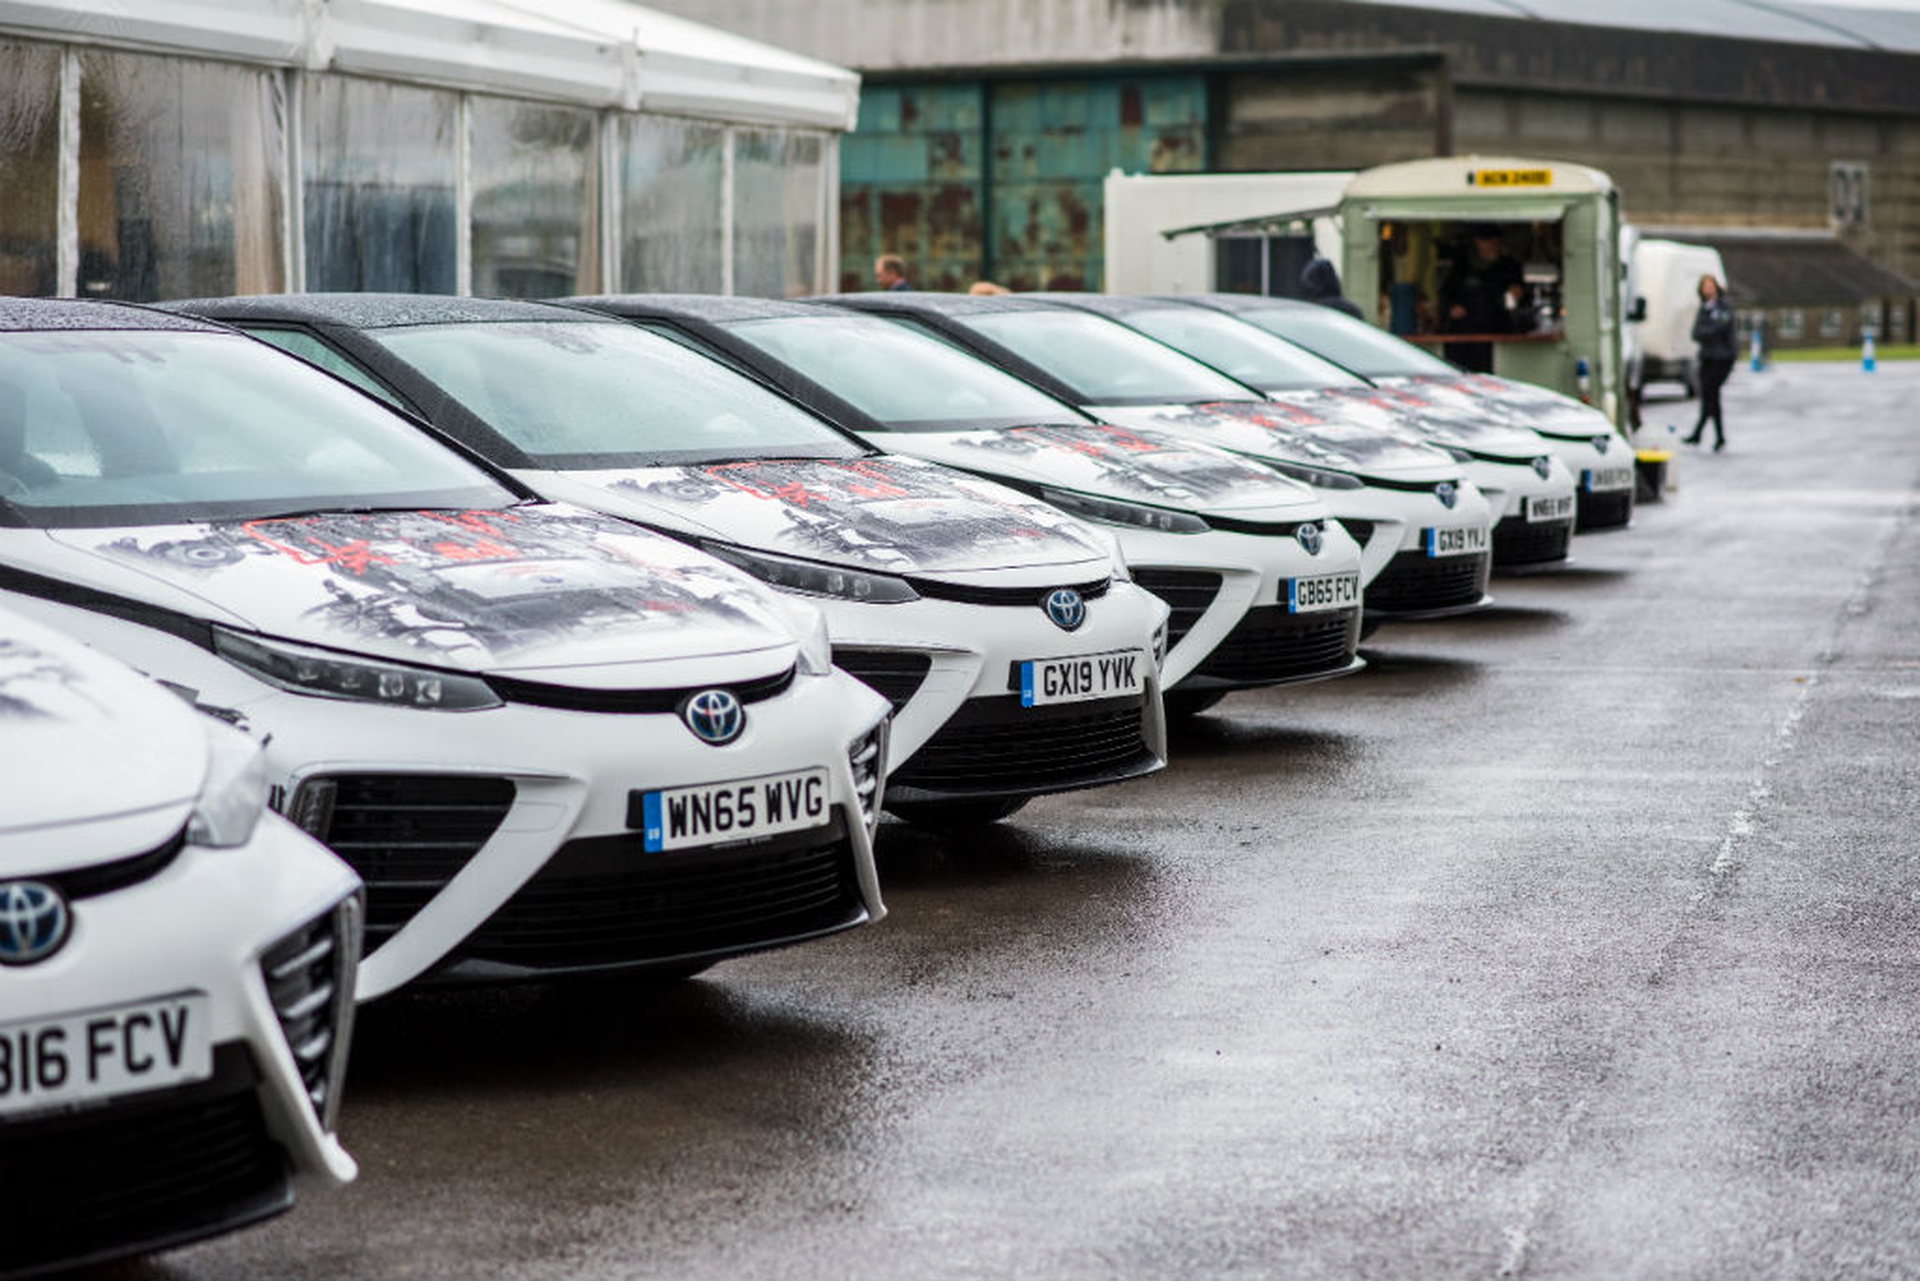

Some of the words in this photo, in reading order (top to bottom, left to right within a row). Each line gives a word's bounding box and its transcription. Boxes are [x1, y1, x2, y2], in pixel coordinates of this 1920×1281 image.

[1298, 579, 1333, 606] GB65
[1336, 575, 1358, 601] FCV
[1044, 661, 1092, 696] GX19
[1098, 656, 1136, 690] YVK
[668, 787, 755, 839] WN65
[765, 776, 822, 824] WVG
[87, 1006, 188, 1083] FCV
